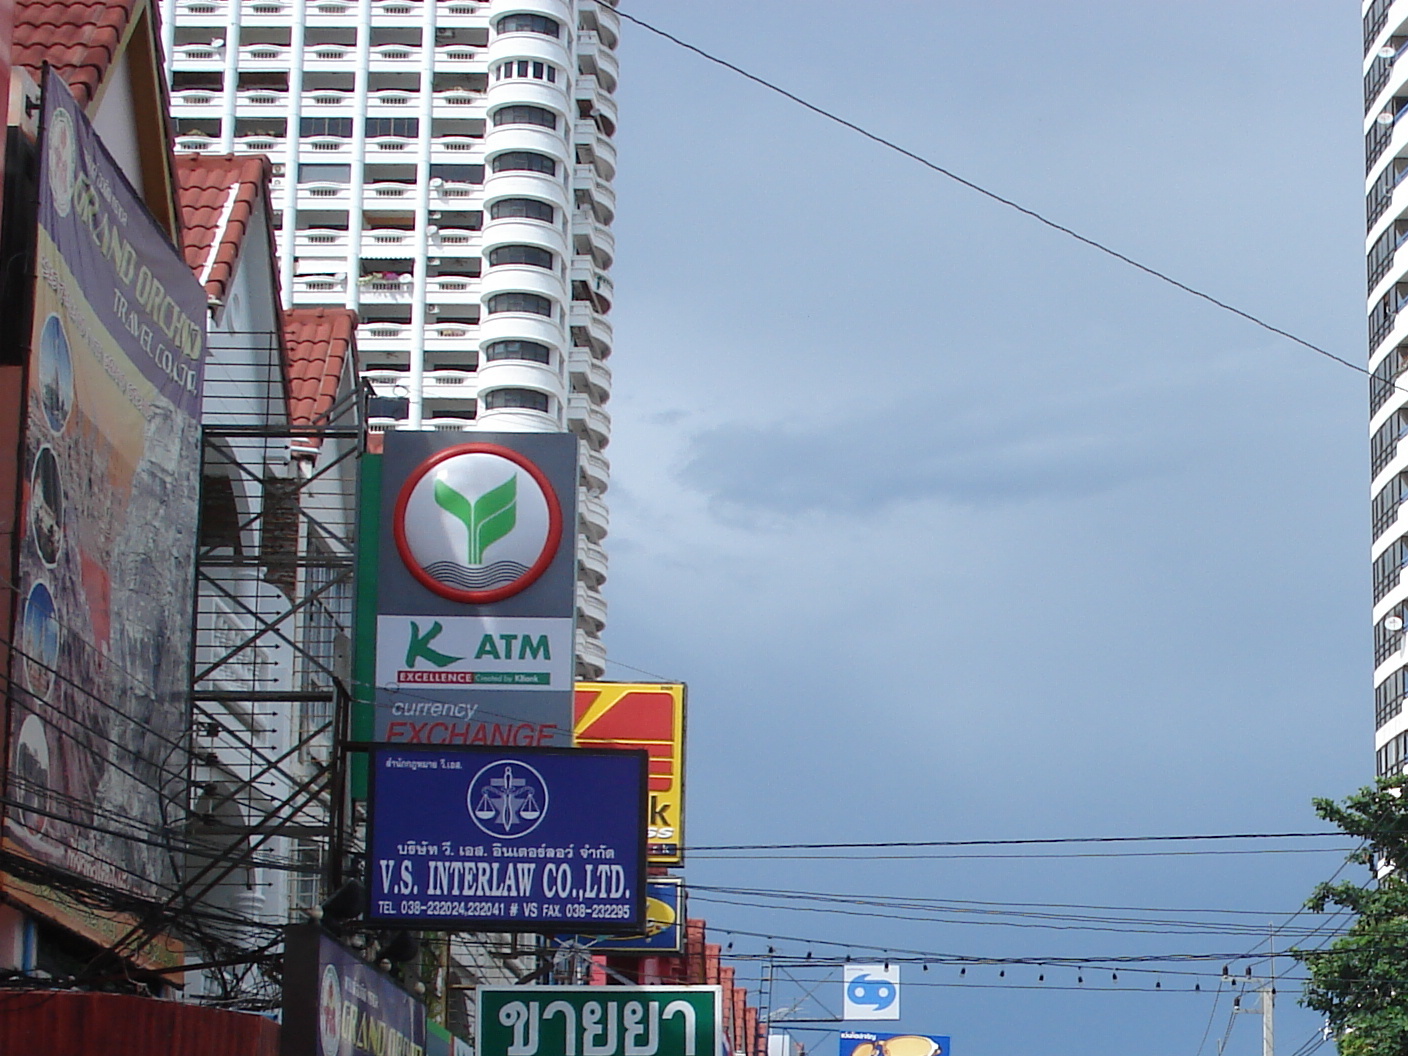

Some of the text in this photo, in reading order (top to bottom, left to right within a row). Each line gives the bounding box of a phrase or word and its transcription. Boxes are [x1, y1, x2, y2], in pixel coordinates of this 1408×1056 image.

[474, 633, 551, 660] ATM
[400, 672, 472, 682] EXCELLENCE
[392, 701, 478, 721] currency
[385, 721, 557, 747] EXCHANGE
[397, 841, 438, 855] บริษัท
[580, 844, 615, 859] จำกัด
[380, 860, 418, 895] V.S.
[427, 861, 536, 898] INTERLAW
[523, 902, 538, 917] VS
[566, 905, 630, 918] 038-232295
[498, 1000, 696, 1056] ขายยา
